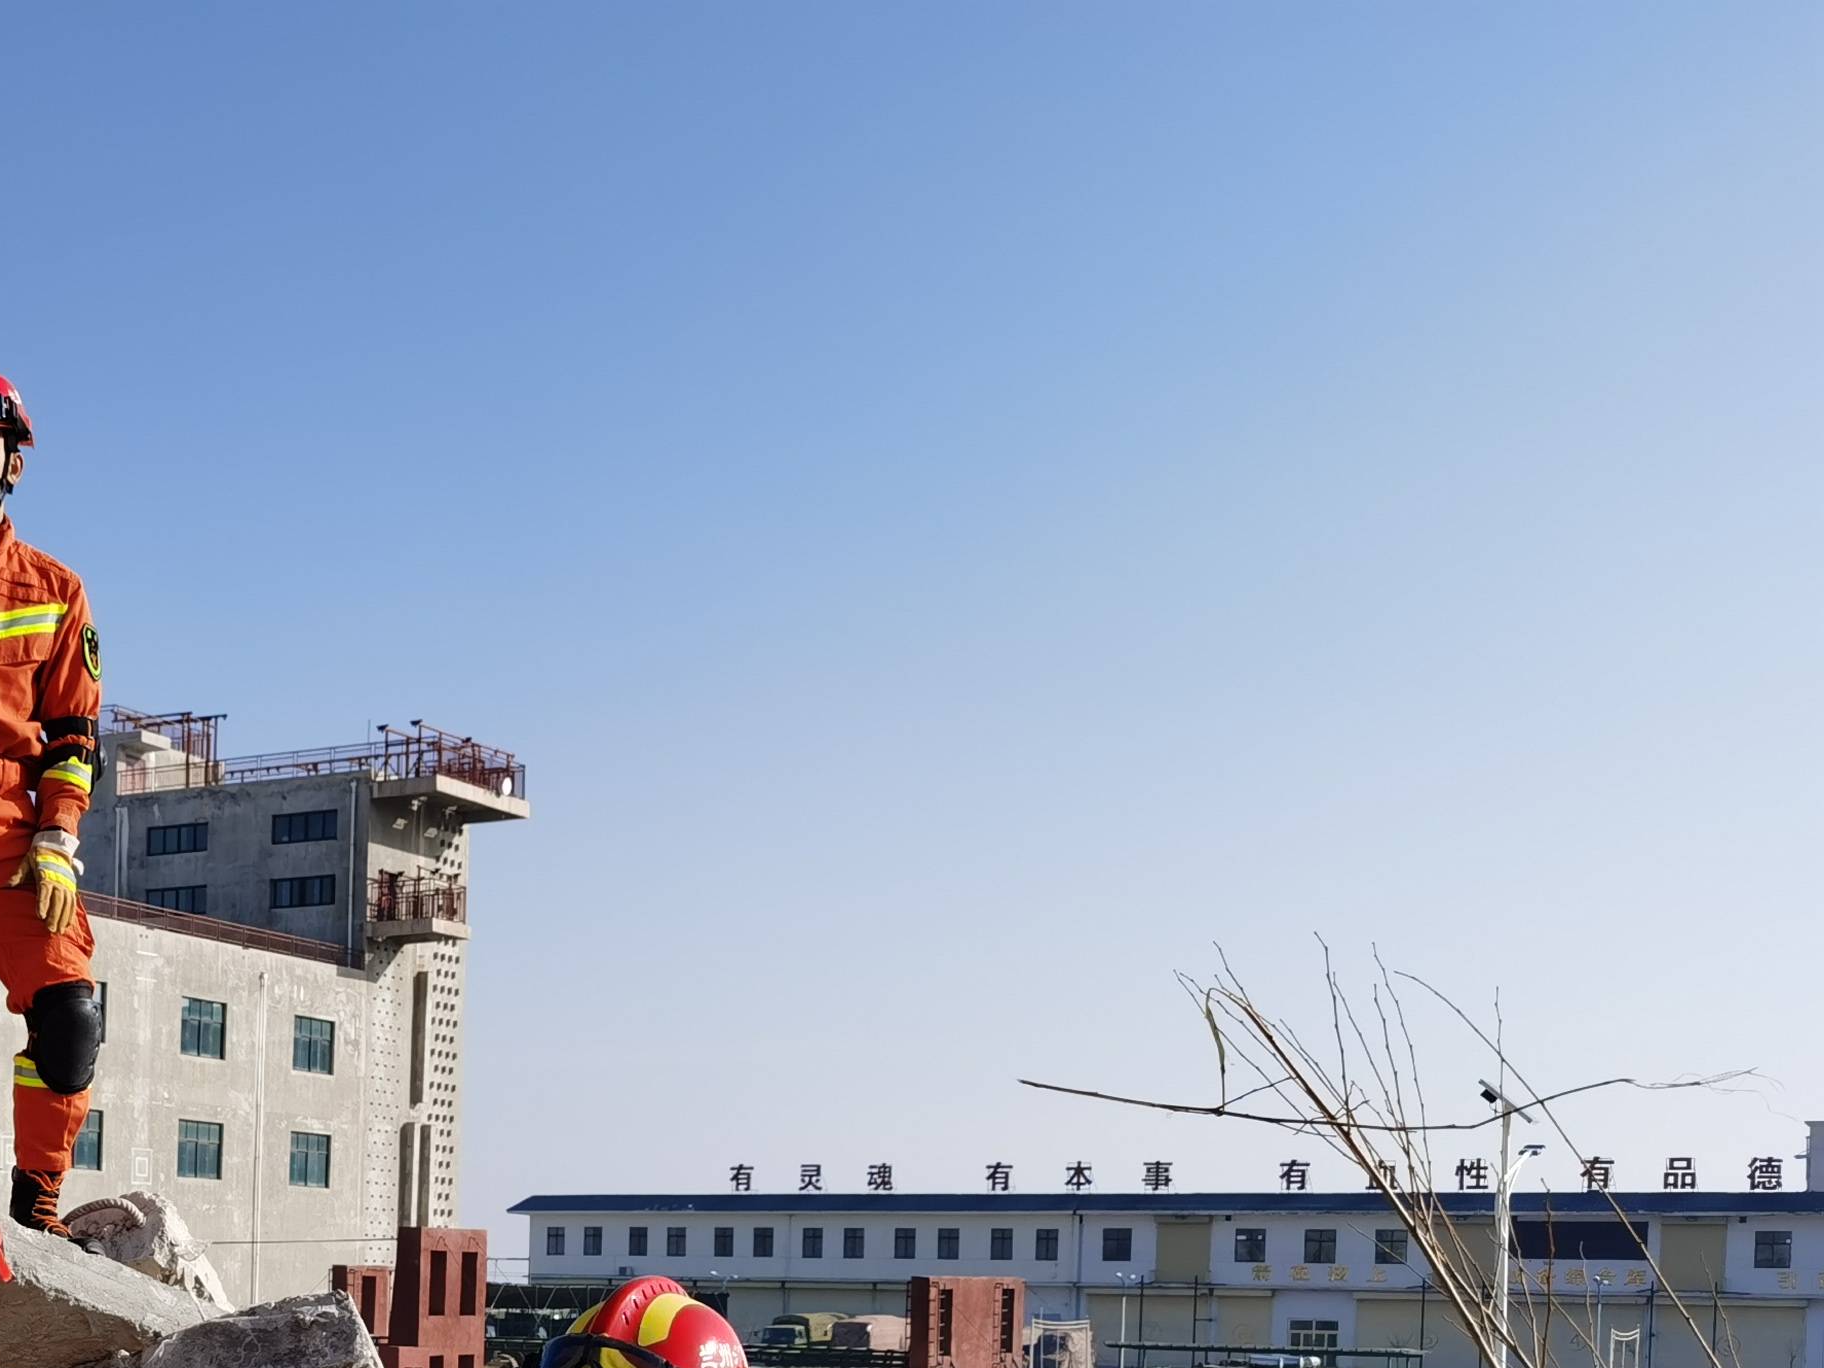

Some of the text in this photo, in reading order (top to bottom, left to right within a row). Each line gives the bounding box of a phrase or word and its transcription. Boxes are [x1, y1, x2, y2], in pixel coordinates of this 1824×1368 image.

[729, 1163, 894, 1191] 有灵魂
[986, 1161, 1173, 1191] 有本事
[1580, 1156, 1783, 1190] 有品德
